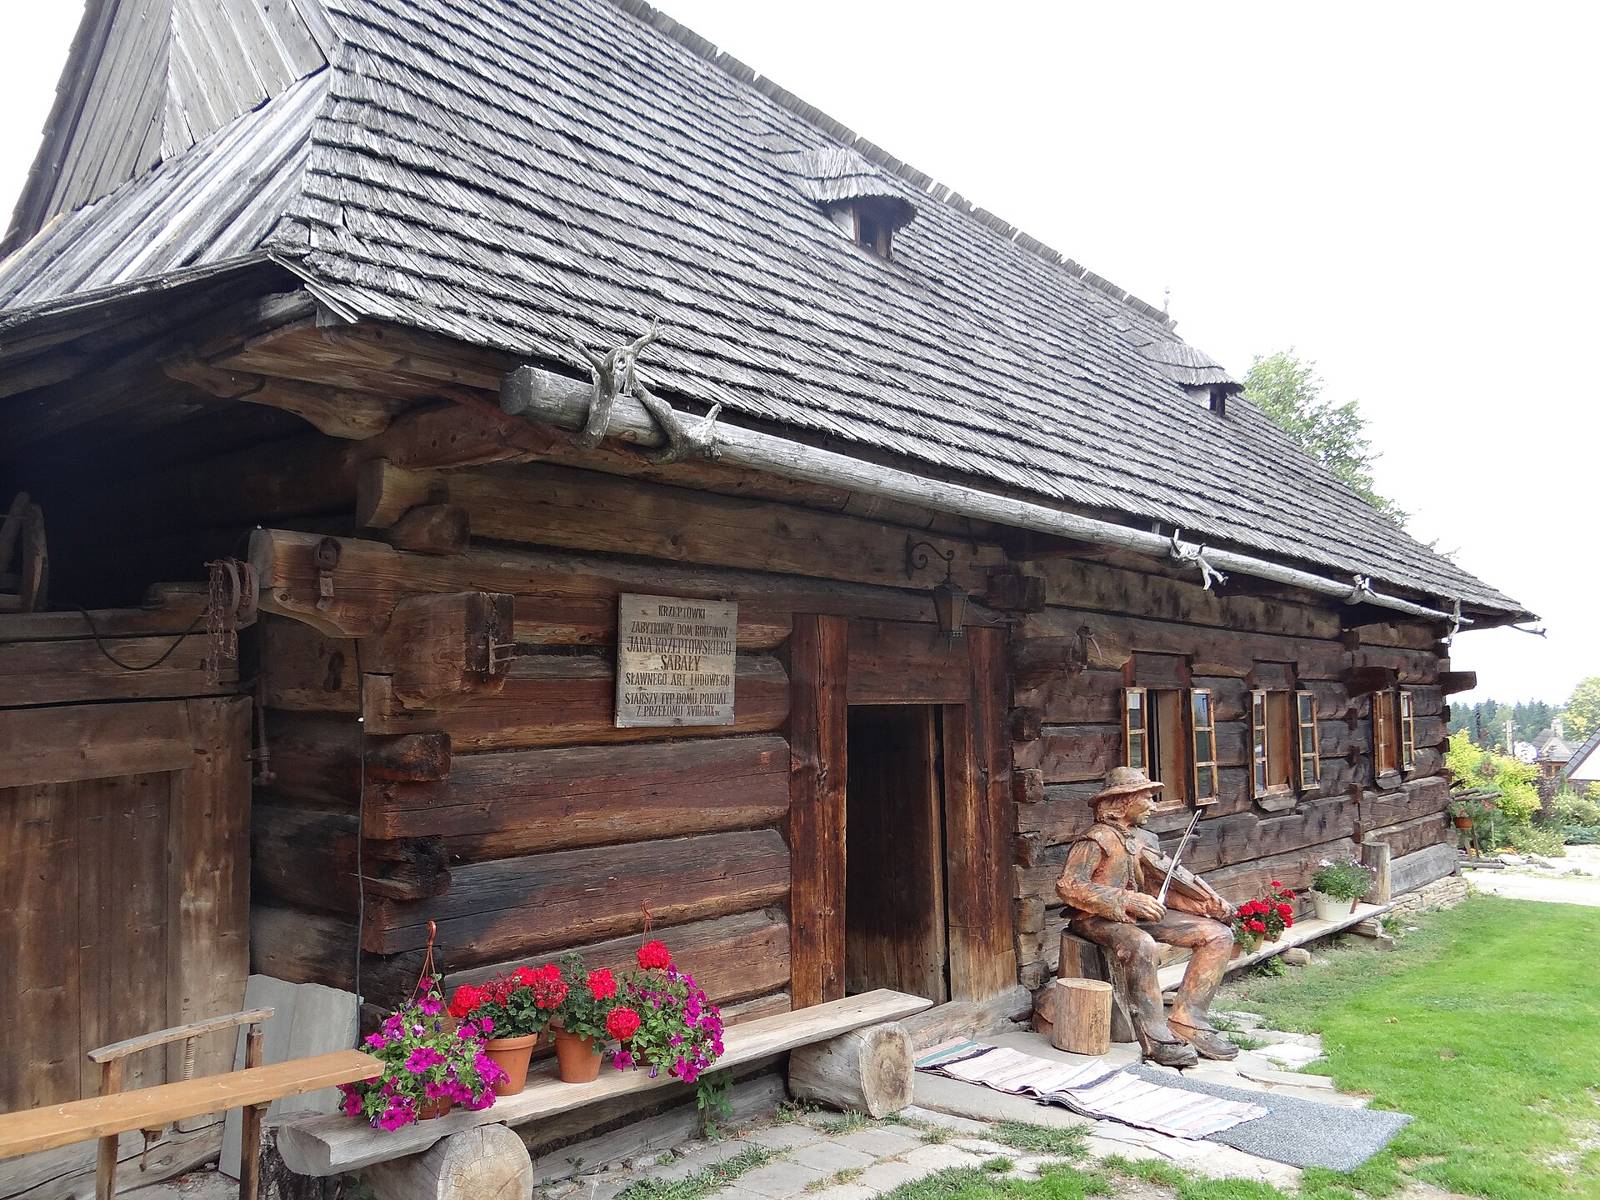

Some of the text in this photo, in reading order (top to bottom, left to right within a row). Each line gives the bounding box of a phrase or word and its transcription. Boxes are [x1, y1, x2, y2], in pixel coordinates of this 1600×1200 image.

[631, 621, 728, 638] ZABYTKOWY DOM RODZINNY
[627, 636, 732, 656] JANA KRZEPTOWSKIEGO
[625, 672, 667, 685] SŁAWNEGO
[690, 673, 730, 687] LUDOWEGO
[625, 692, 658, 704] STARSZY
[661, 693, 674, 704] TYP
[677, 693, 697, 704] DOMU
[636, 705, 641, 717] Z
[643, 705, 683, 717] PRZEŁOMU
